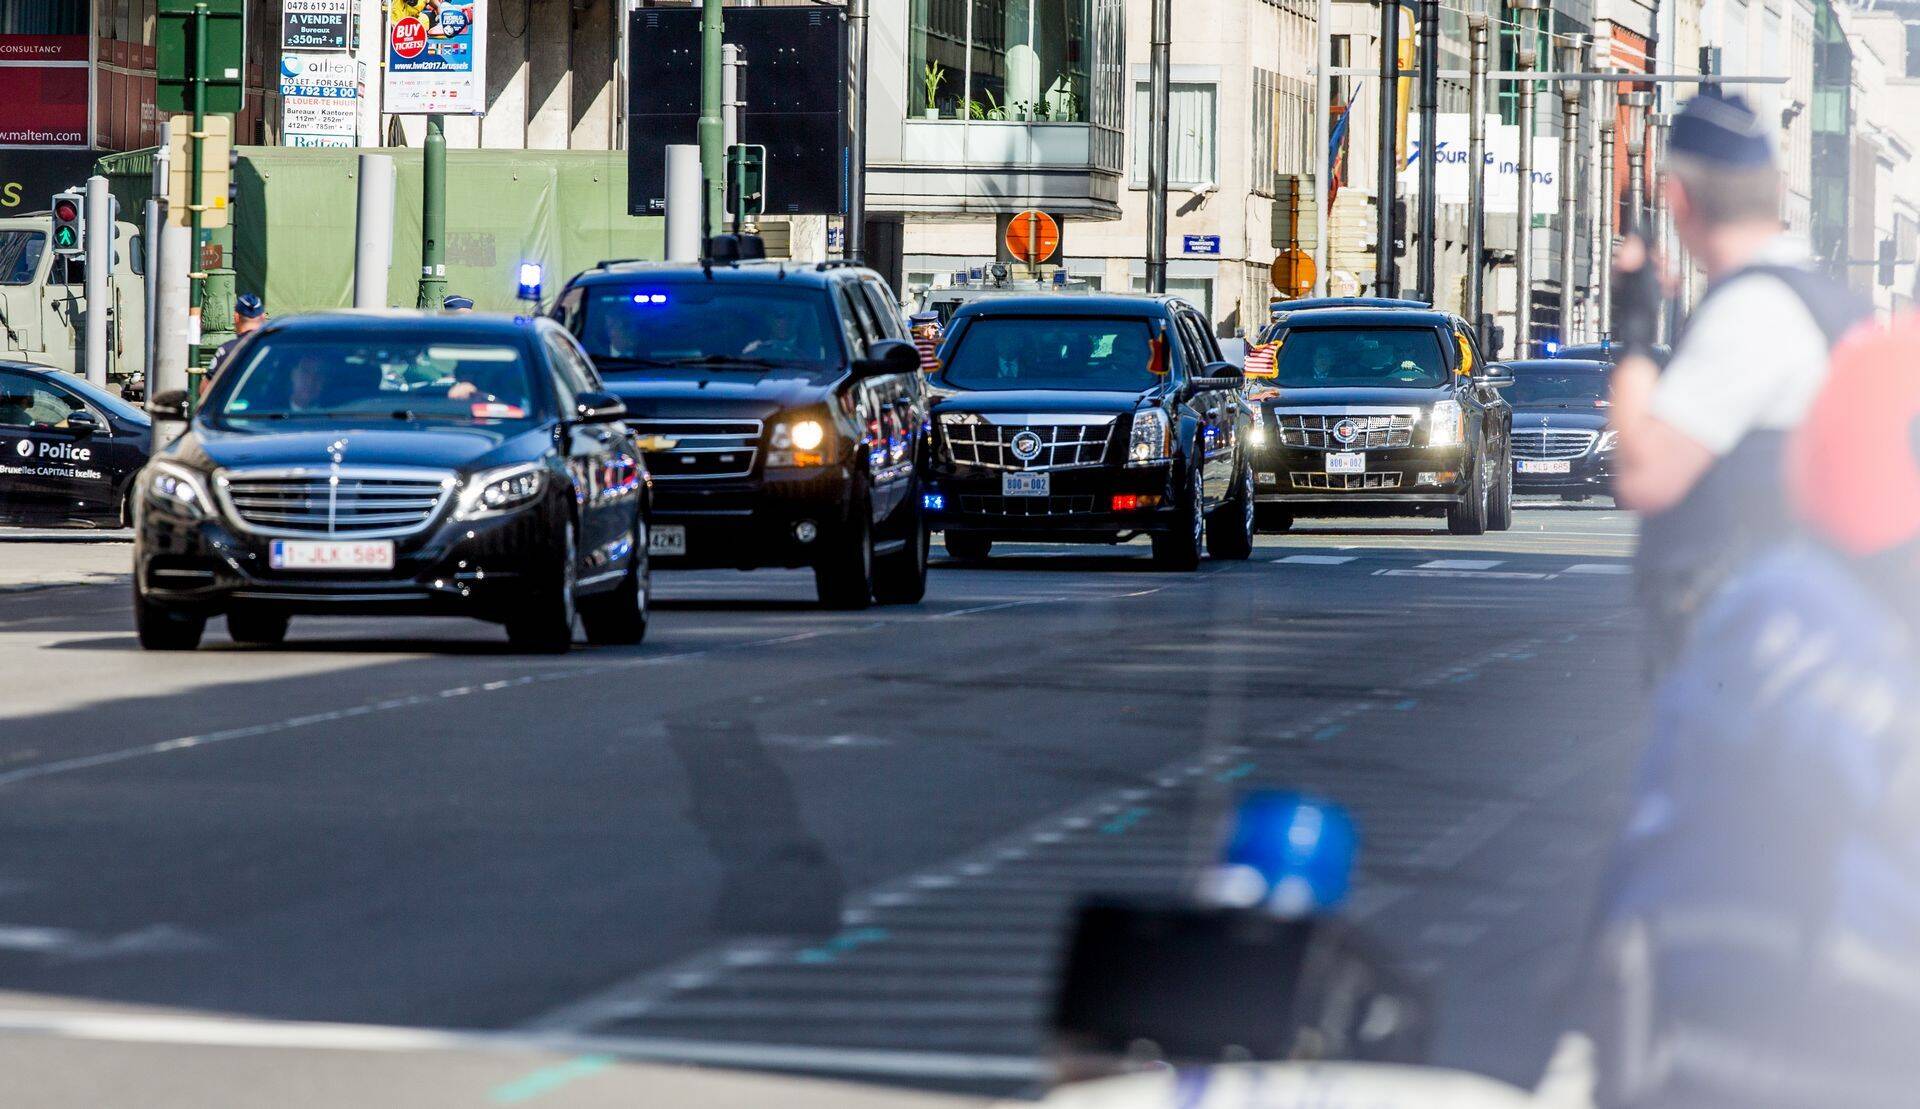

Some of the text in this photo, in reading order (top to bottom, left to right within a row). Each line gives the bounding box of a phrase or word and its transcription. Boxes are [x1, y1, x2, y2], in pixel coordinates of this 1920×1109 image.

[287, 2, 308, 10] 0478
[311, 2, 326, 10] 619
[290, 15, 343, 24] A VENDRE
[396, 23, 420, 38] BUY
[0, 45, 62, 53] CONSULTANCY
[334, 80, 354, 88] SALE
[283, 86, 355, 97] 02 792 92 00
[39, 442, 91, 461] Police
[37, 467, 74, 477] CAPITALE
